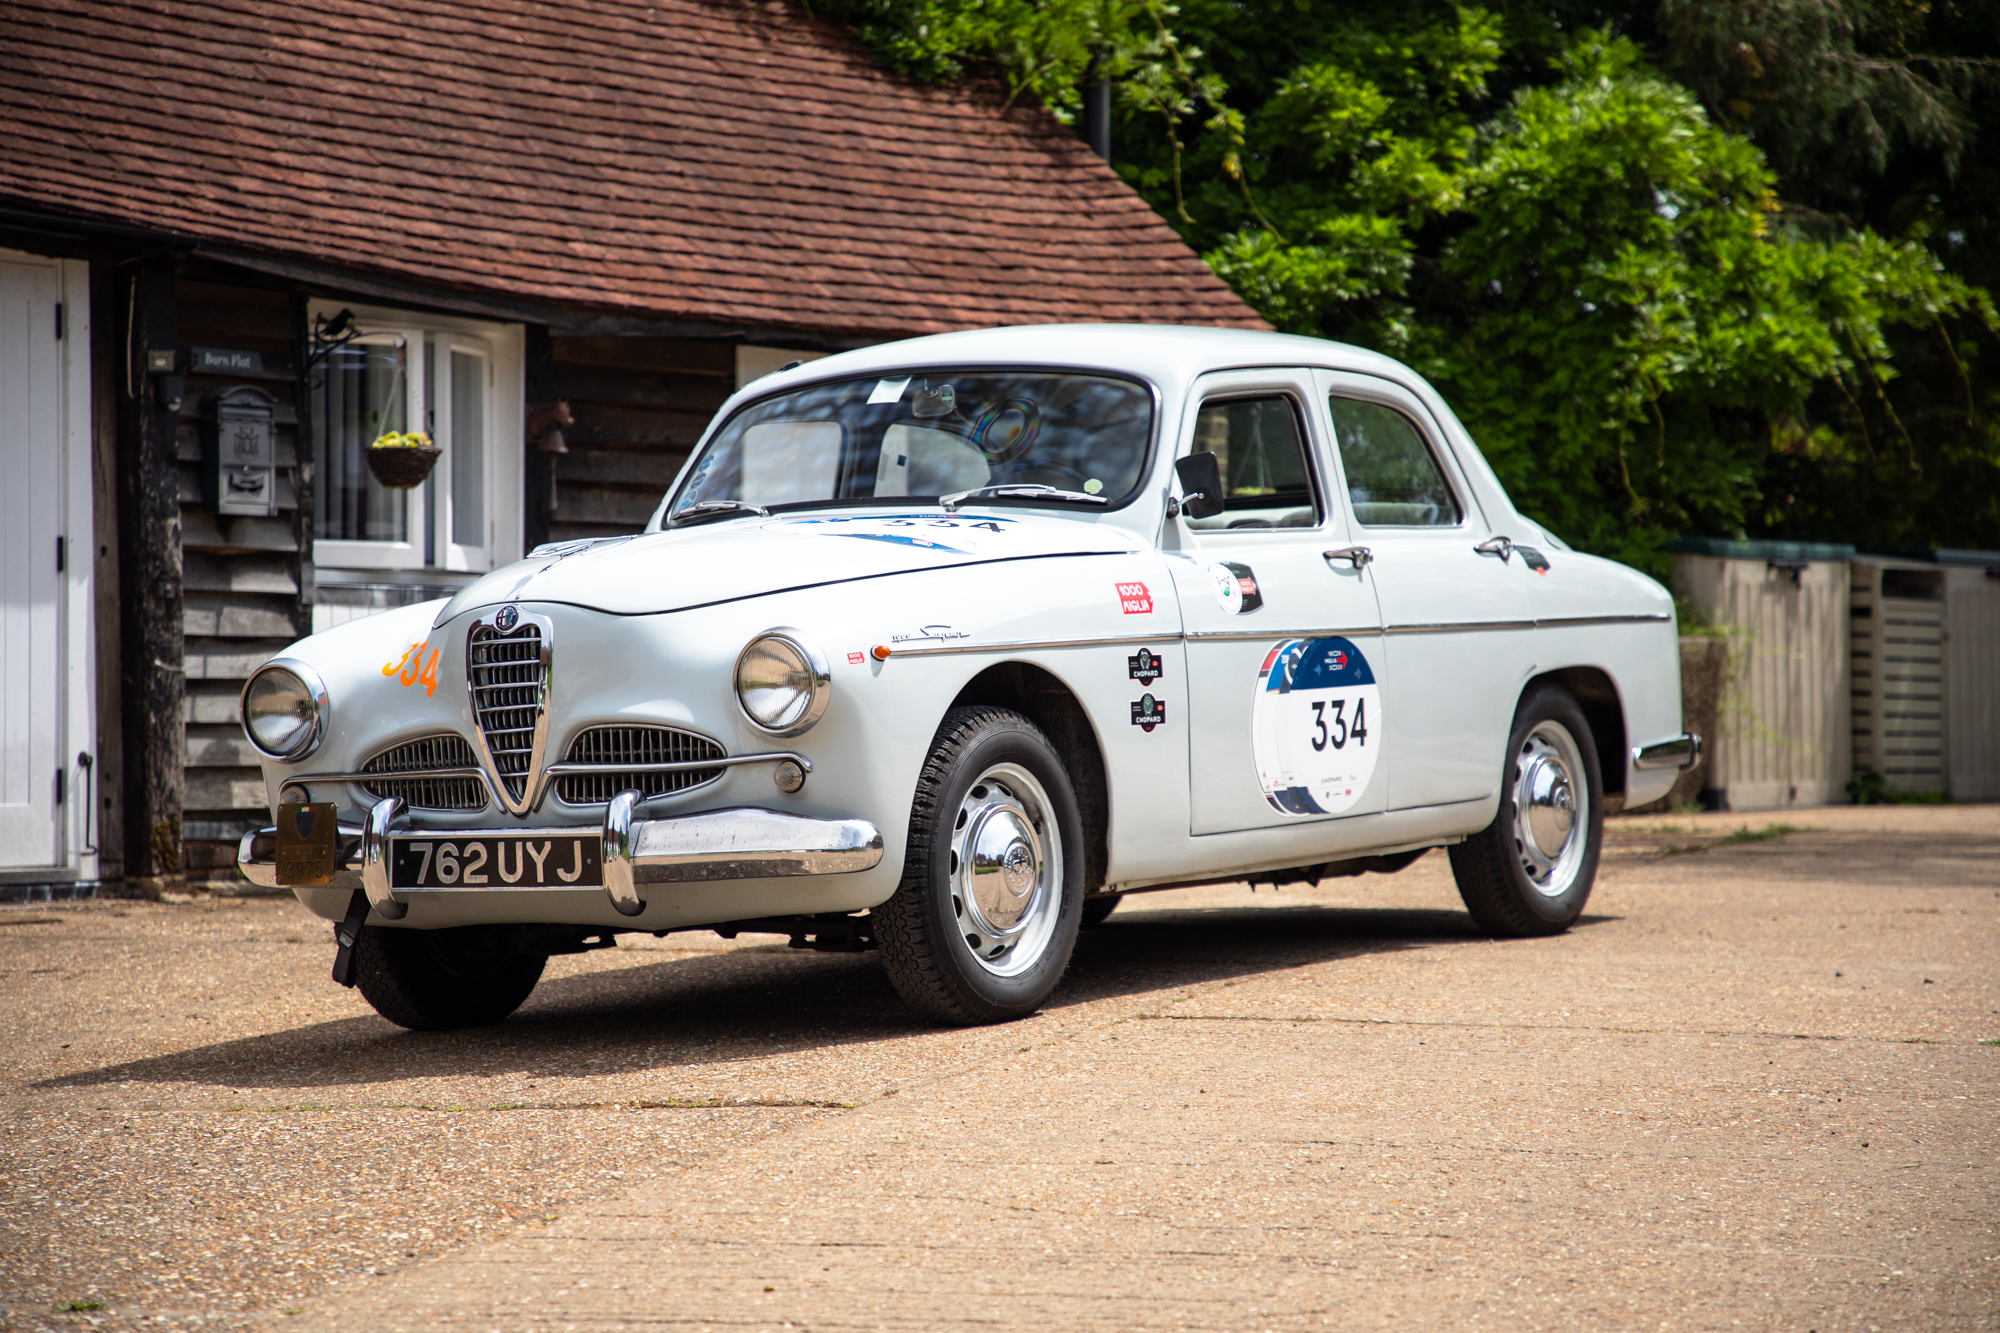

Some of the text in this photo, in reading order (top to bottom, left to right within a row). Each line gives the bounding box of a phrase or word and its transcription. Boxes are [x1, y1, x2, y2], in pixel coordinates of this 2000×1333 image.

[1119, 584, 1143, 597] 1000
[1123, 599, 1151, 612] MIGLIA
[382, 640, 440, 698] 334
[1133, 669, 1159, 678] CHOPARD
[1135, 715, 1162, 724] CHOPARD
[1311, 697, 1367, 752] 334
[1321, 776, 1342, 784] CHOPARD
[409, 840, 583, 885] 762 UYJ
[286, 861, 324, 879] 3975
